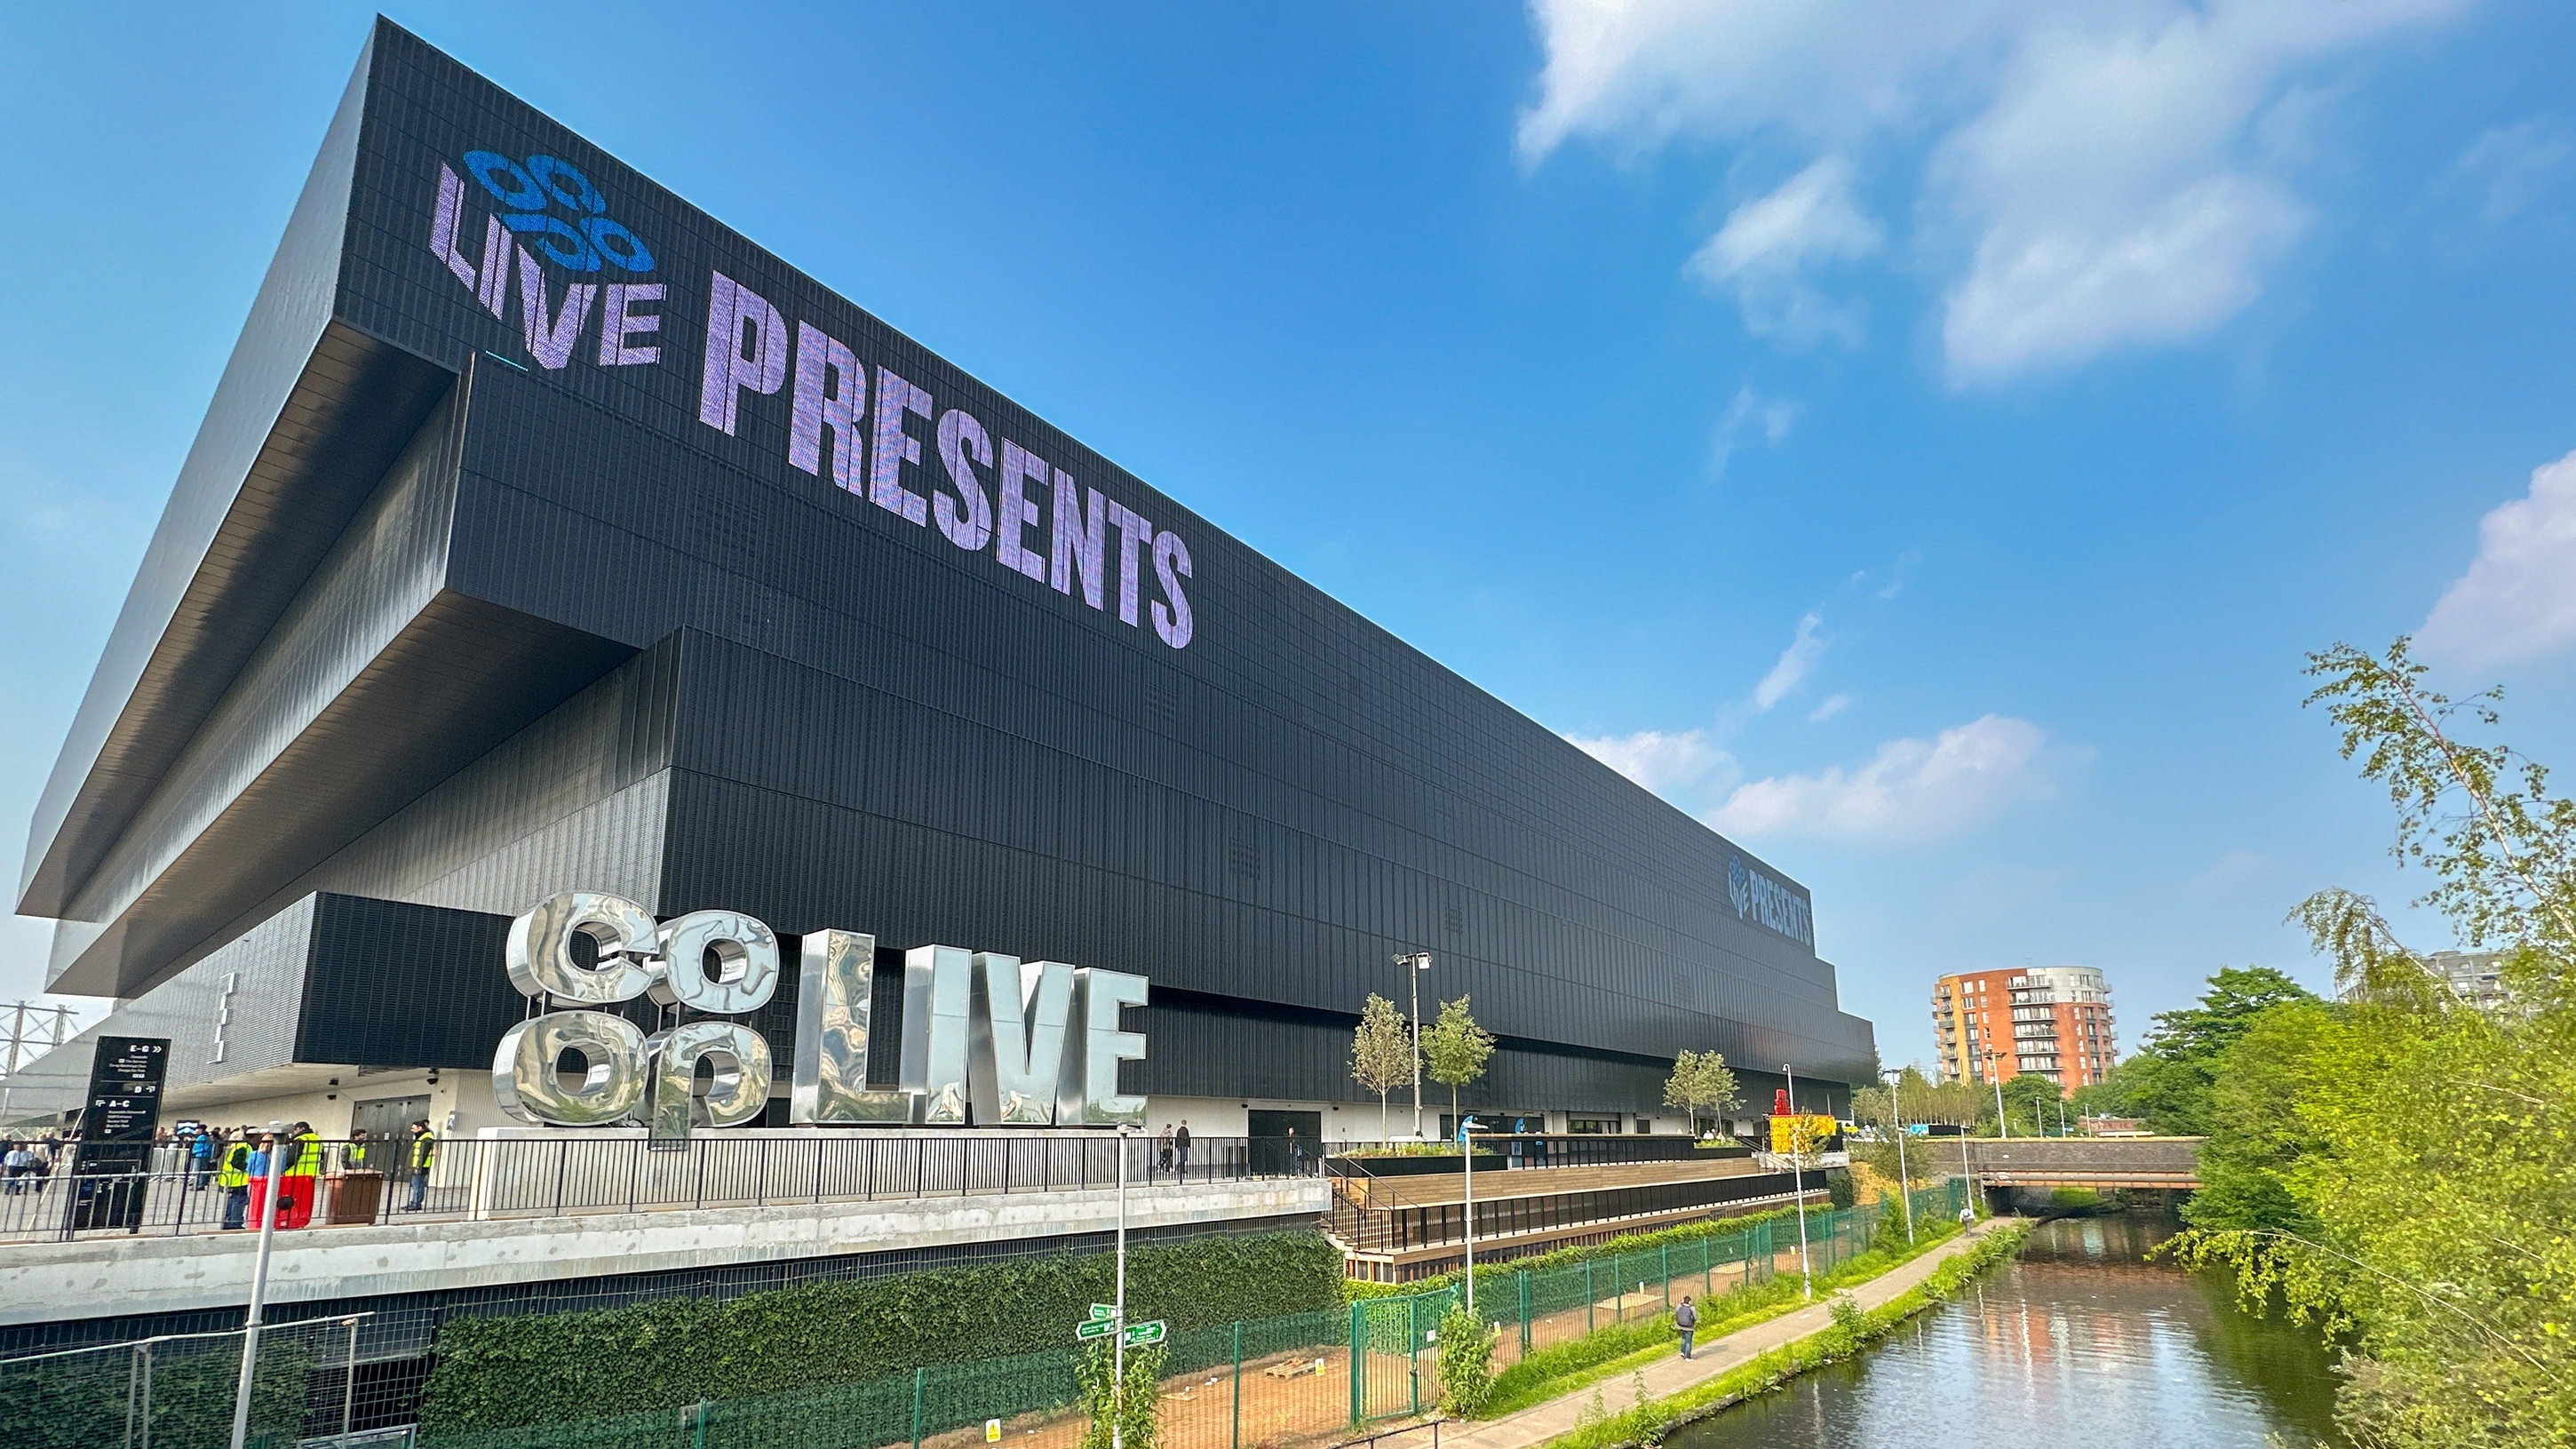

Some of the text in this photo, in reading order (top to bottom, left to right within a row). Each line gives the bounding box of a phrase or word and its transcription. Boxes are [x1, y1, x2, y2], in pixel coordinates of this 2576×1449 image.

[429, 160, 667, 370] LIVE
[698, 268, 1193, 649] PRESENTS
[1728, 871, 1749, 920] LIVE
[1749, 869, 1811, 946] PRESENTS
[791, 928, 1149, 1126] LIVE
